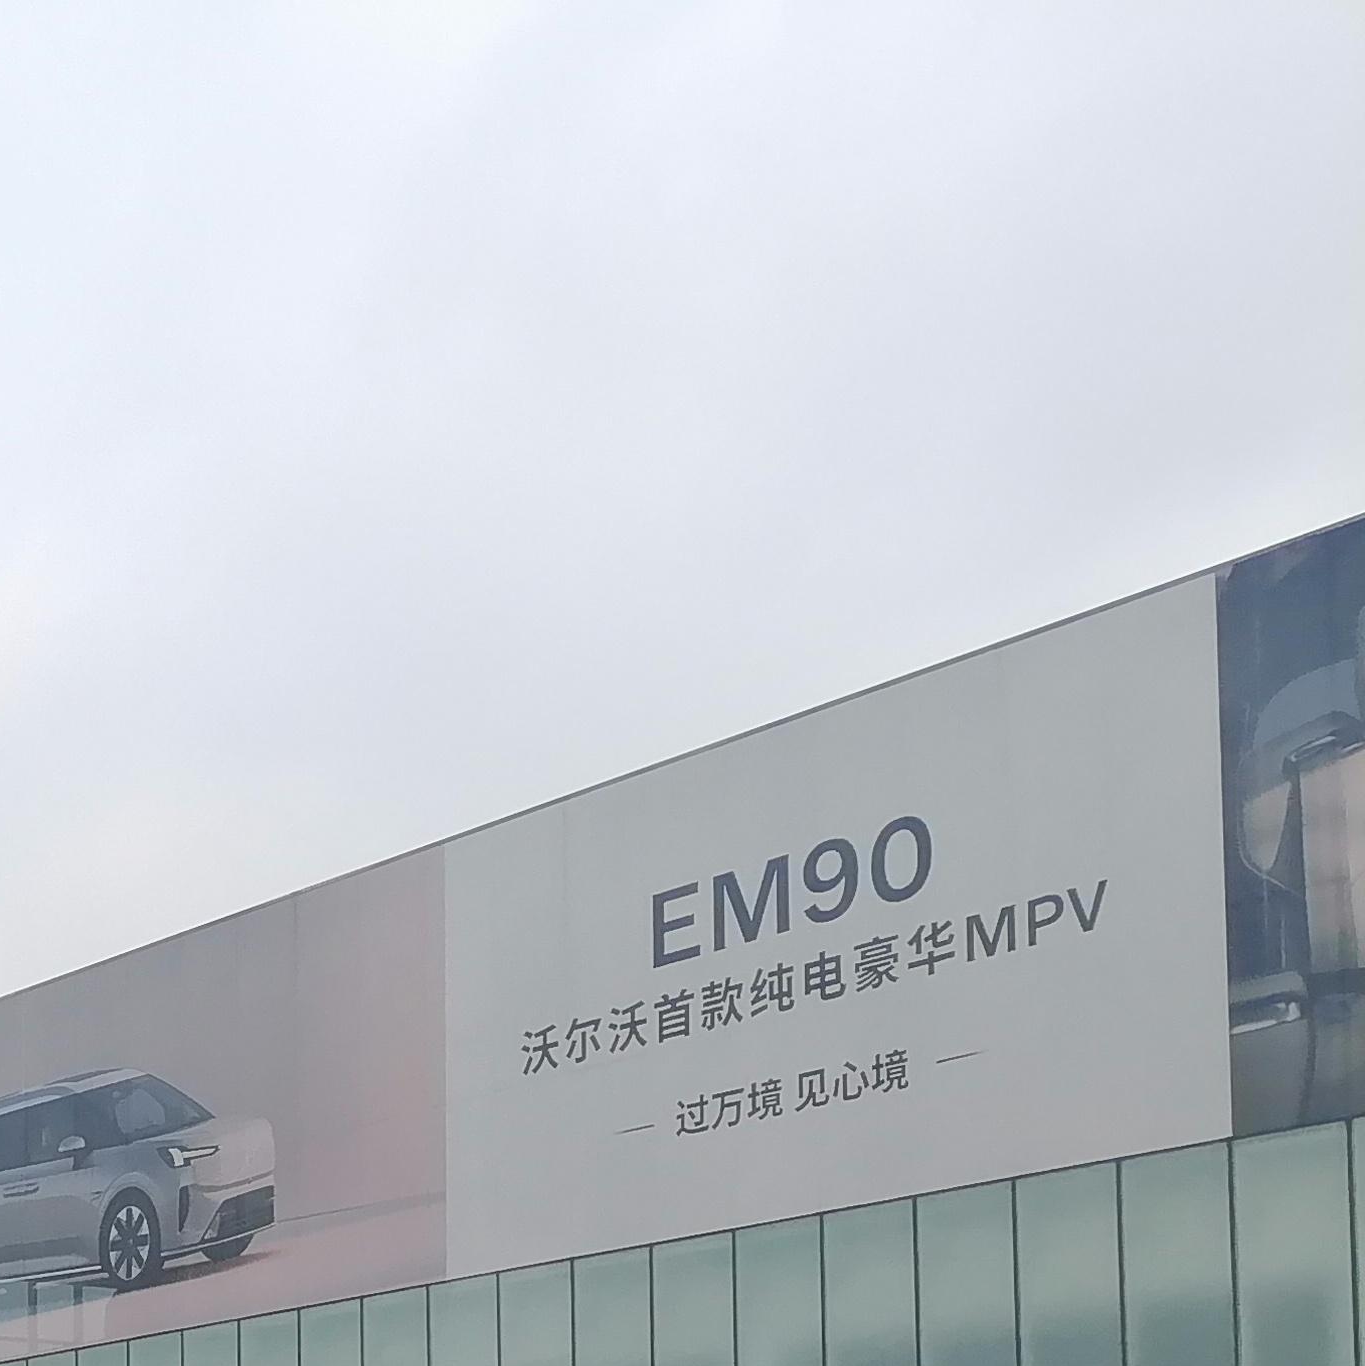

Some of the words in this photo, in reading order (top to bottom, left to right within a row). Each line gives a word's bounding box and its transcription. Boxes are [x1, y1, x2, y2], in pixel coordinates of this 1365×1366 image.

[652, 816, 933, 968] EM90
[520, 879, 1109, 1076] 沃尔沃首款纯电豪华MPV
[675, 1076, 784, 1138] 过万境
[794, 1048, 910, 1112] 见心境
